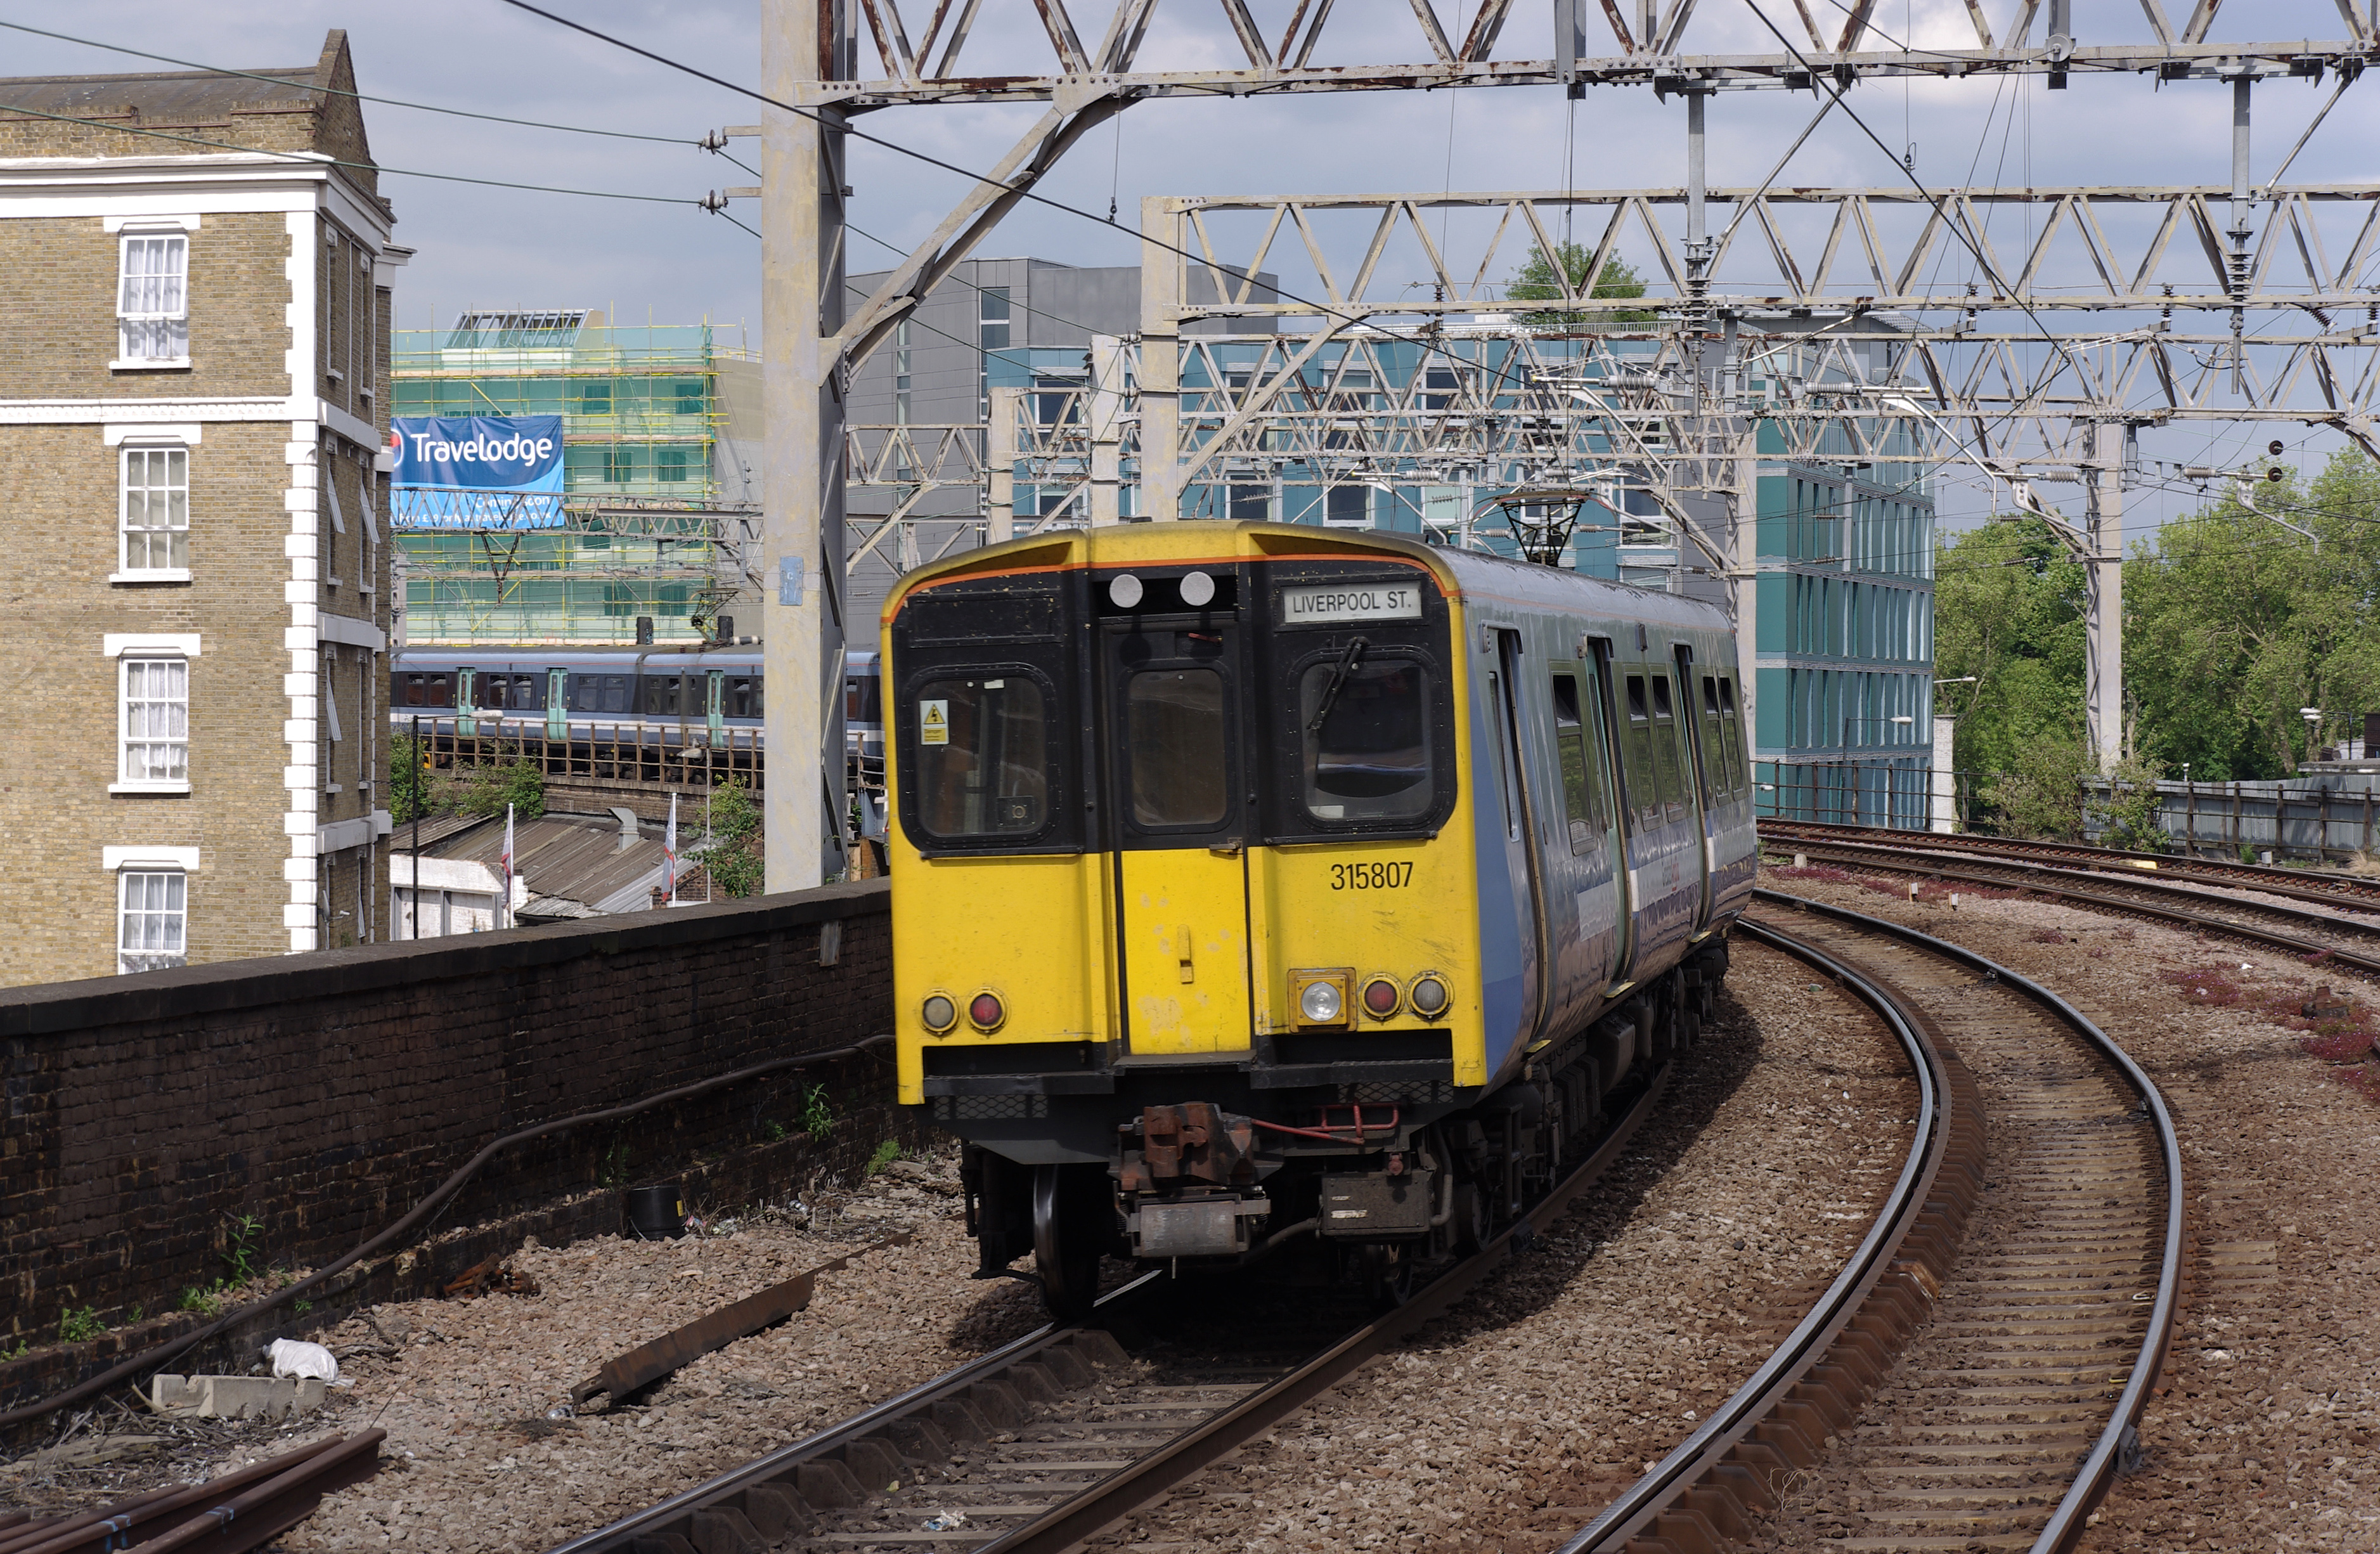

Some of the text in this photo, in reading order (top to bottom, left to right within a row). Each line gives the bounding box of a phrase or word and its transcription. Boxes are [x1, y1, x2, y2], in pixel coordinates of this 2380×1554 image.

[410, 432, 552, 467] Travelodge
[475, 496, 519, 509] Cmin
[422, 514, 439, 522] £9
[1293, 591, 1411, 613] LIVERPOOL ST.
[1330, 861, 1414, 891] 315807
